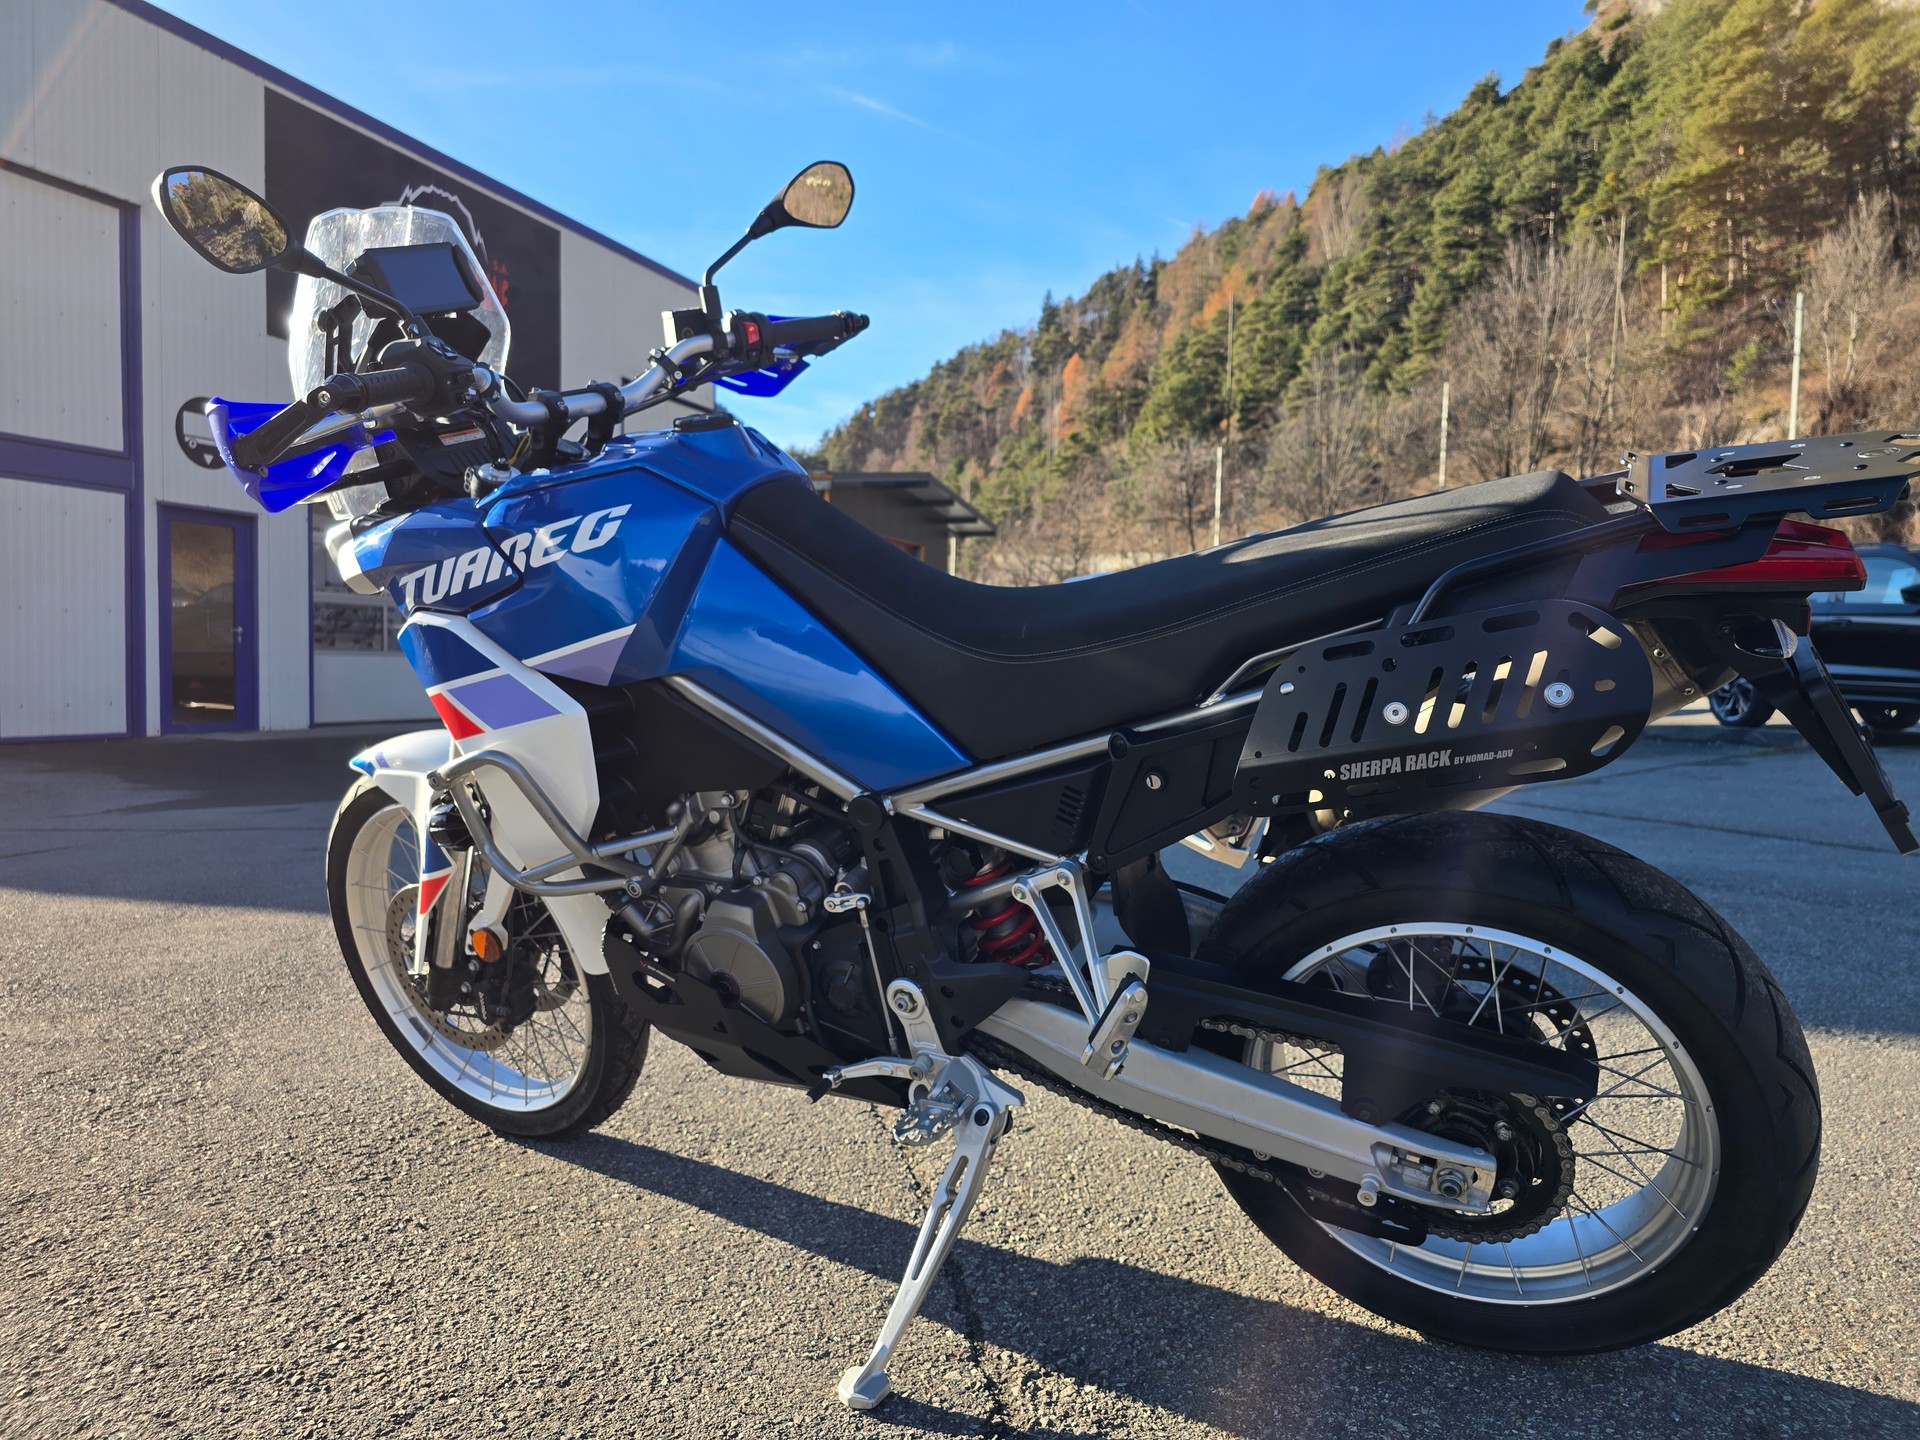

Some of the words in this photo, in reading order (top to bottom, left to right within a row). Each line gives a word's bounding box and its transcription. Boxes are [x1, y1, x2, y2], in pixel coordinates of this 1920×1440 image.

[399, 503, 633, 611] TUAREG
[1339, 756, 1402, 781] SHERPA
[1405, 749, 1452, 772] RACK
[1453, 756, 1465, 765] BY
[1465, 748, 1514, 763] NOMAD-ADV
